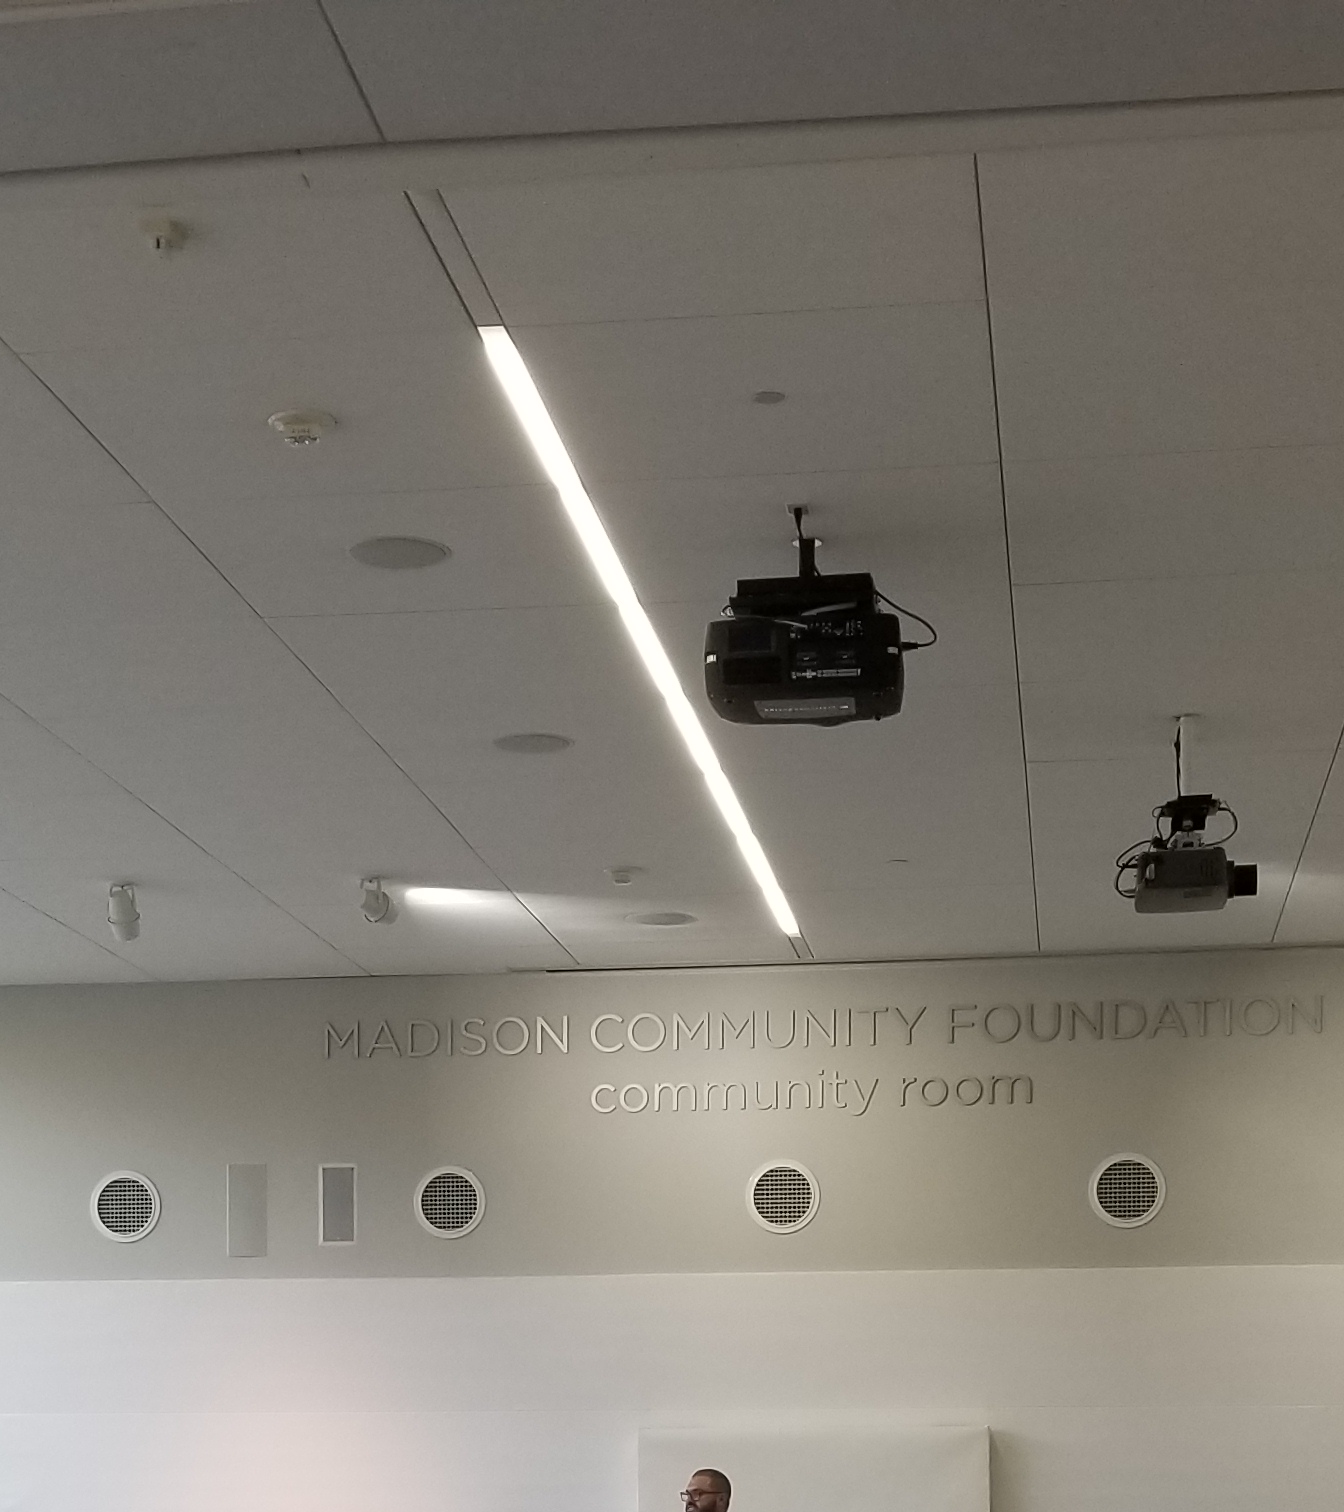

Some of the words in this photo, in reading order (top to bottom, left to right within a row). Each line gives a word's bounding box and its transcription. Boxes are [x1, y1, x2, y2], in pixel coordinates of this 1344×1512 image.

[323, 1015, 570, 1058] MADISON
[590, 1006, 927, 1054] COMMUNITY
[947, 995, 1325, 1045] FOUNDATION
[590, 1070, 879, 1117] community
[900, 1074, 1034, 1107] room
